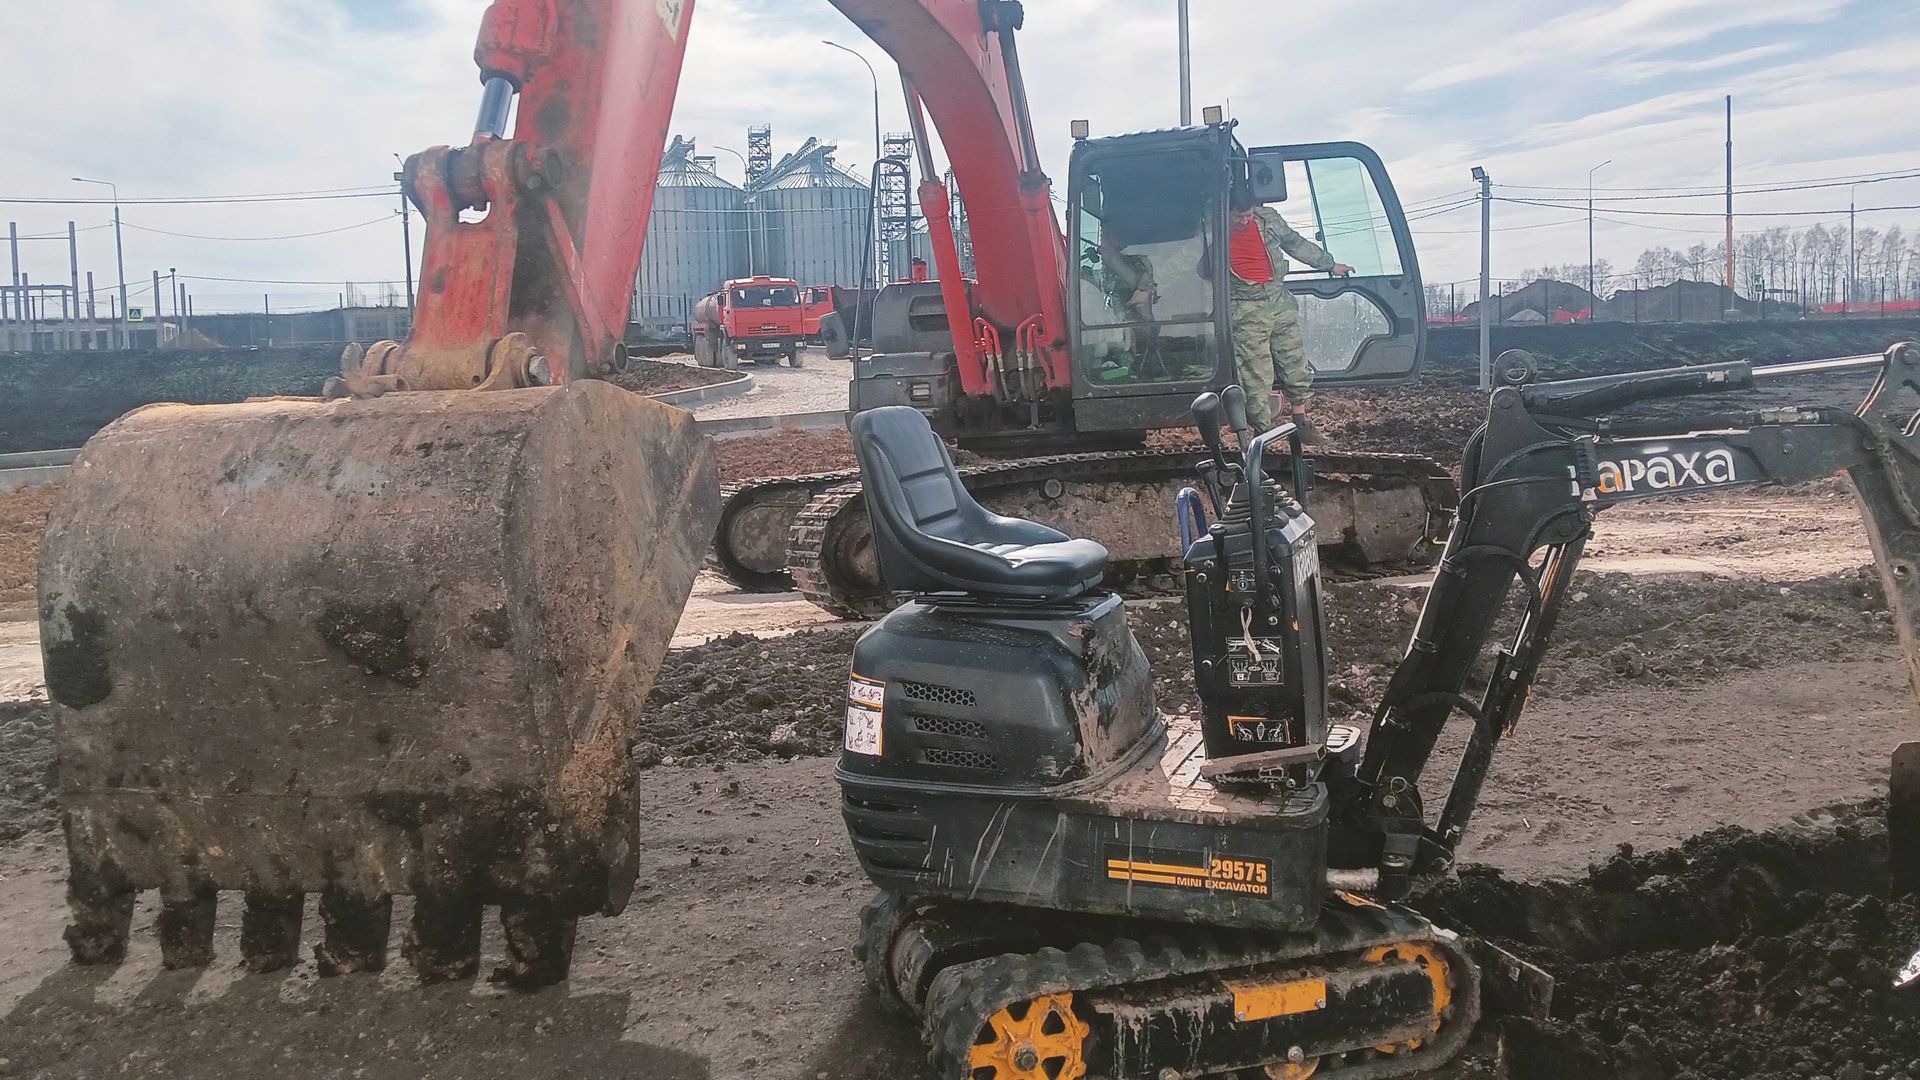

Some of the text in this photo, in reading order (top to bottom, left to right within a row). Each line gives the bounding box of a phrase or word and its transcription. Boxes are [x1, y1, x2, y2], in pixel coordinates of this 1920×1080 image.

[1211, 858, 1268, 883] 29575
[1176, 876, 1268, 895] MINI EXCAVATOR
